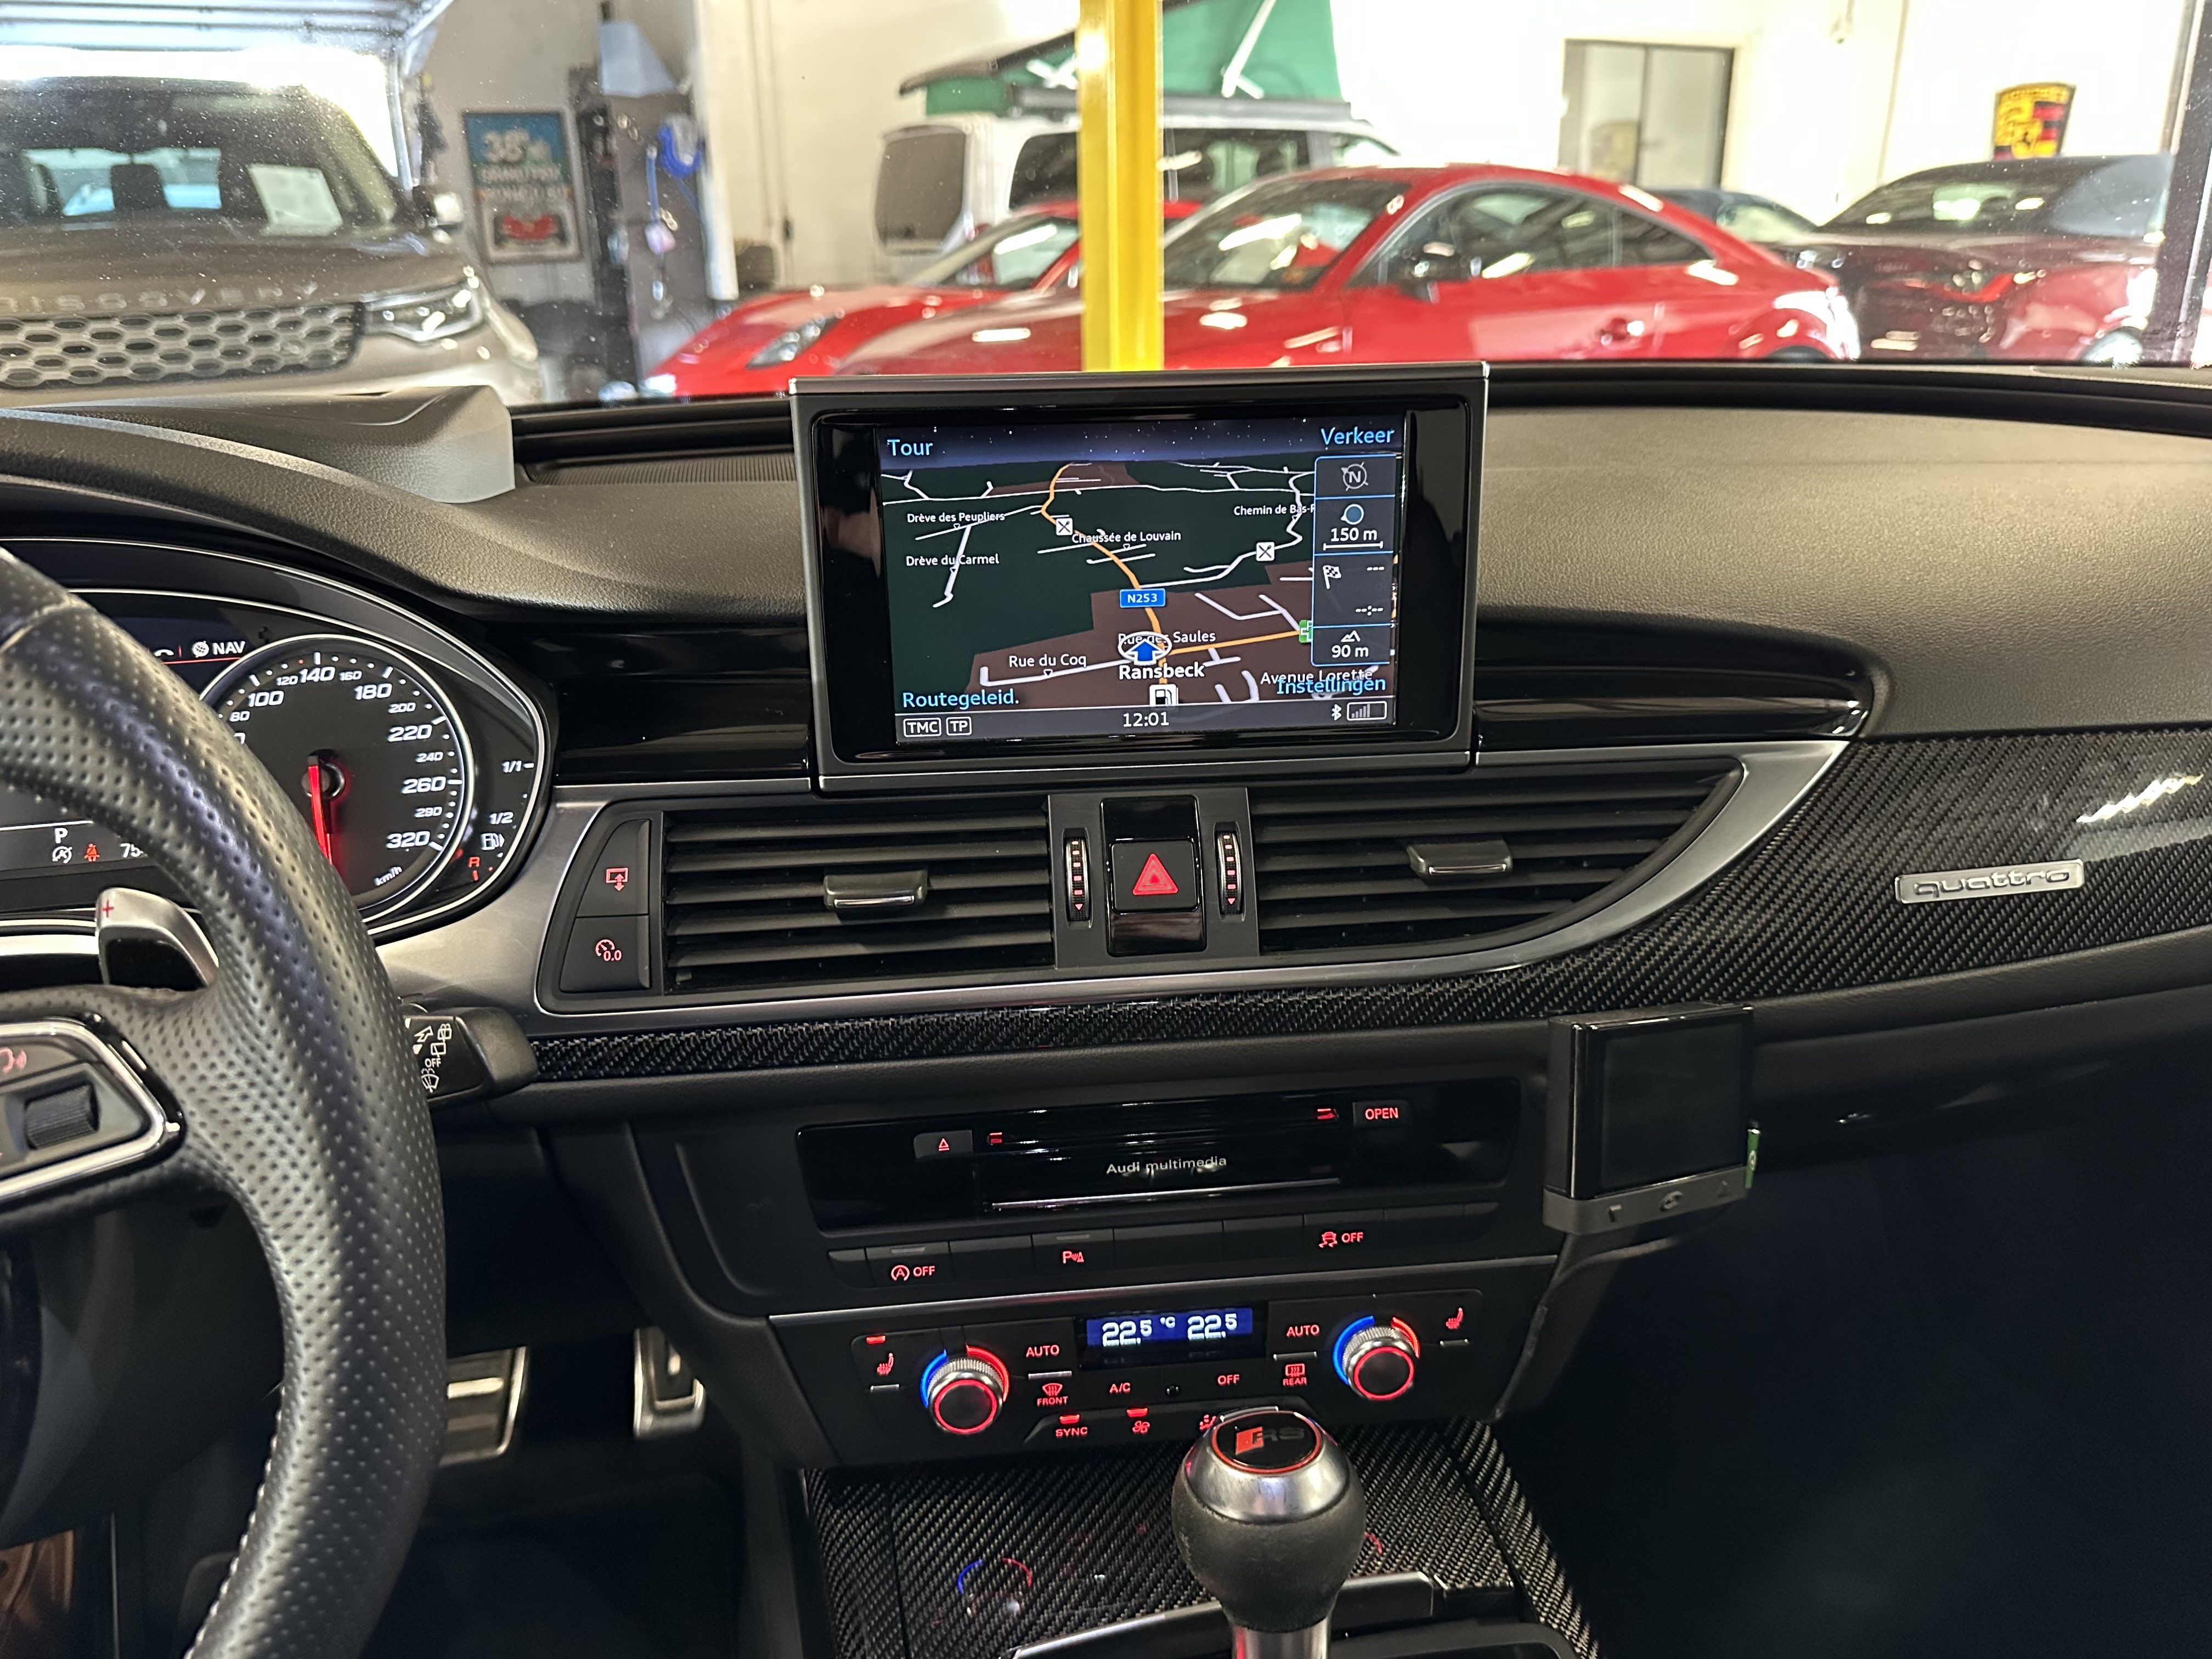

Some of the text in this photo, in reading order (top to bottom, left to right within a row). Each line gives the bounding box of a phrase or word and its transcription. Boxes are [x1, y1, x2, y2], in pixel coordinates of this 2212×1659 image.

[1321, 427, 1395, 445] Verkeer
[887, 439, 933, 456] Tour
[1234, 505, 1272, 515] Chemin
[1275, 504, 1287, 514] de
[907, 511, 1005, 524] Drève des Peupliers
[1071, 531, 1182, 544] Chaussée de Louvain
[1331, 528, 1378, 542] 150 m
[906, 554, 1000, 567] Drève du Carmel
[1127, 592, 1158, 603] N253
[1173, 630, 1216, 644] Saules
[213, 641, 245, 654] NAV
[1331, 646, 1369, 658] 90 m
[1008, 653, 1087, 668] Rue du Coq
[299, 667, 335, 682] 140
[340, 670, 362, 681] 160
[1119, 661, 1205, 680] Ransbeck
[1260, 669, 1373, 685] Avenue Lorette
[276, 675, 298, 686] 120
[1277, 676, 1386, 696] Instellingen
[247, 691, 284, 707] 100
[354, 684, 392, 700] 180
[902, 688, 1019, 711] Routegeleid.
[388, 702, 416, 714] 200
[229, 711, 250, 722] 80
[1122, 712, 1170, 727] 12:01
[388, 724, 432, 742] 220
[907, 719, 968, 735] TMC TP
[415, 752, 443, 763] 240
[502, 760, 522, 773] 1/1
[402, 776, 447, 794] 260
[415, 806, 442, 818] 290
[489, 812, 514, 825] 1/2
[55, 828, 68, 844] P
[386, 831, 431, 849] 320
[120, 843, 143, 858] 75
[469, 856, 481, 868] R
[374, 865, 403, 887] km/h
[1914, 869, 2069, 898] quattro
[603, 950, 622, 962] 0.0
[425, 1058, 441, 1068] OFF
[1364, 1107, 1399, 1121] OPEN
[1106, 1155, 1227, 1175] Audi multimedia
[1341, 1231, 1364, 1244] OFF
[913, 1265, 935, 1278] OFF
[1102, 1319, 1152, 1347] 22.5
[1187, 1313, 1238, 1341] 22.5
[1286, 1324, 1320, 1338] AUTO
[1026, 1344, 1060, 1358] AUTO
[1217, 1373, 1240, 1386] OFF
[1283, 1376, 1307, 1387] REAR
[1109, 1381, 1131, 1395] A/C
[1036, 1396, 1069, 1407] FRONT
[1055, 1426, 1088, 1438] SYNC
[1252, 1426, 1305, 1445] RS
